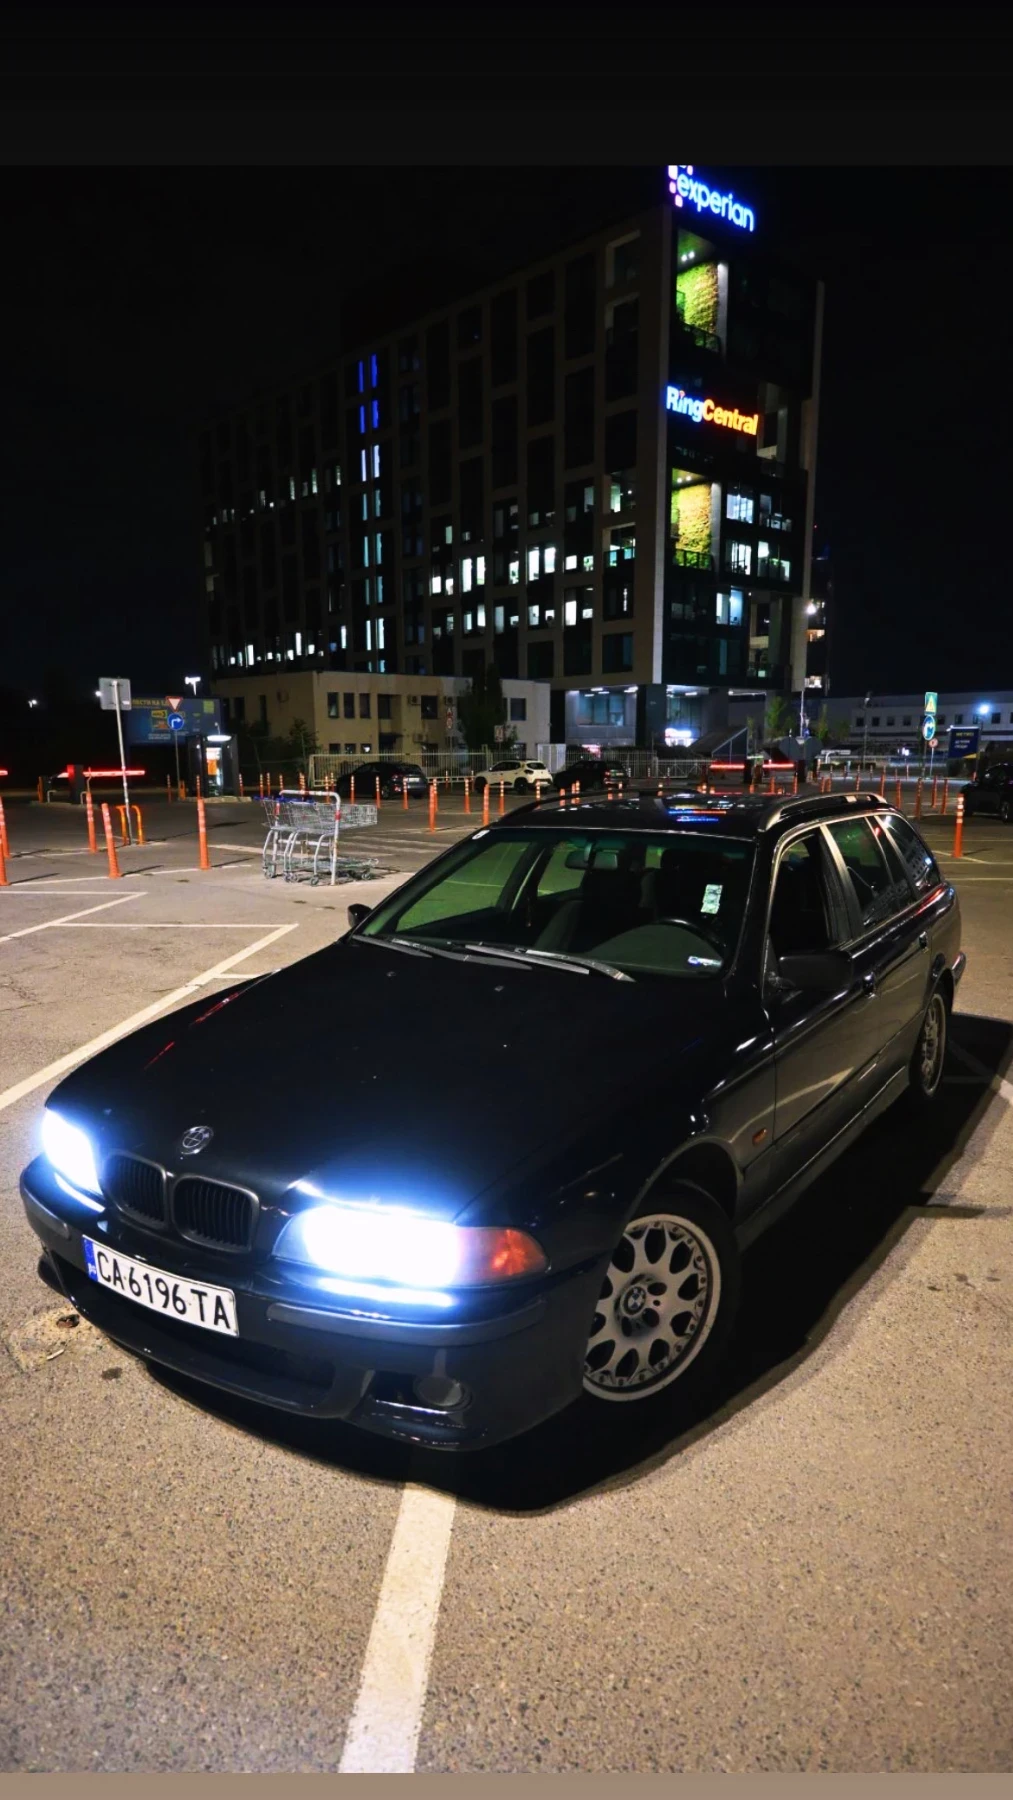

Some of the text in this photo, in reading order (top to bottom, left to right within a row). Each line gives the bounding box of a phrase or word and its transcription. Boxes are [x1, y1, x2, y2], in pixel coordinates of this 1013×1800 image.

[677, 173, 754, 232] experian
[666, 385, 759, 435] RingCentral
[97, 1251, 231, 1329] CA6196TA
